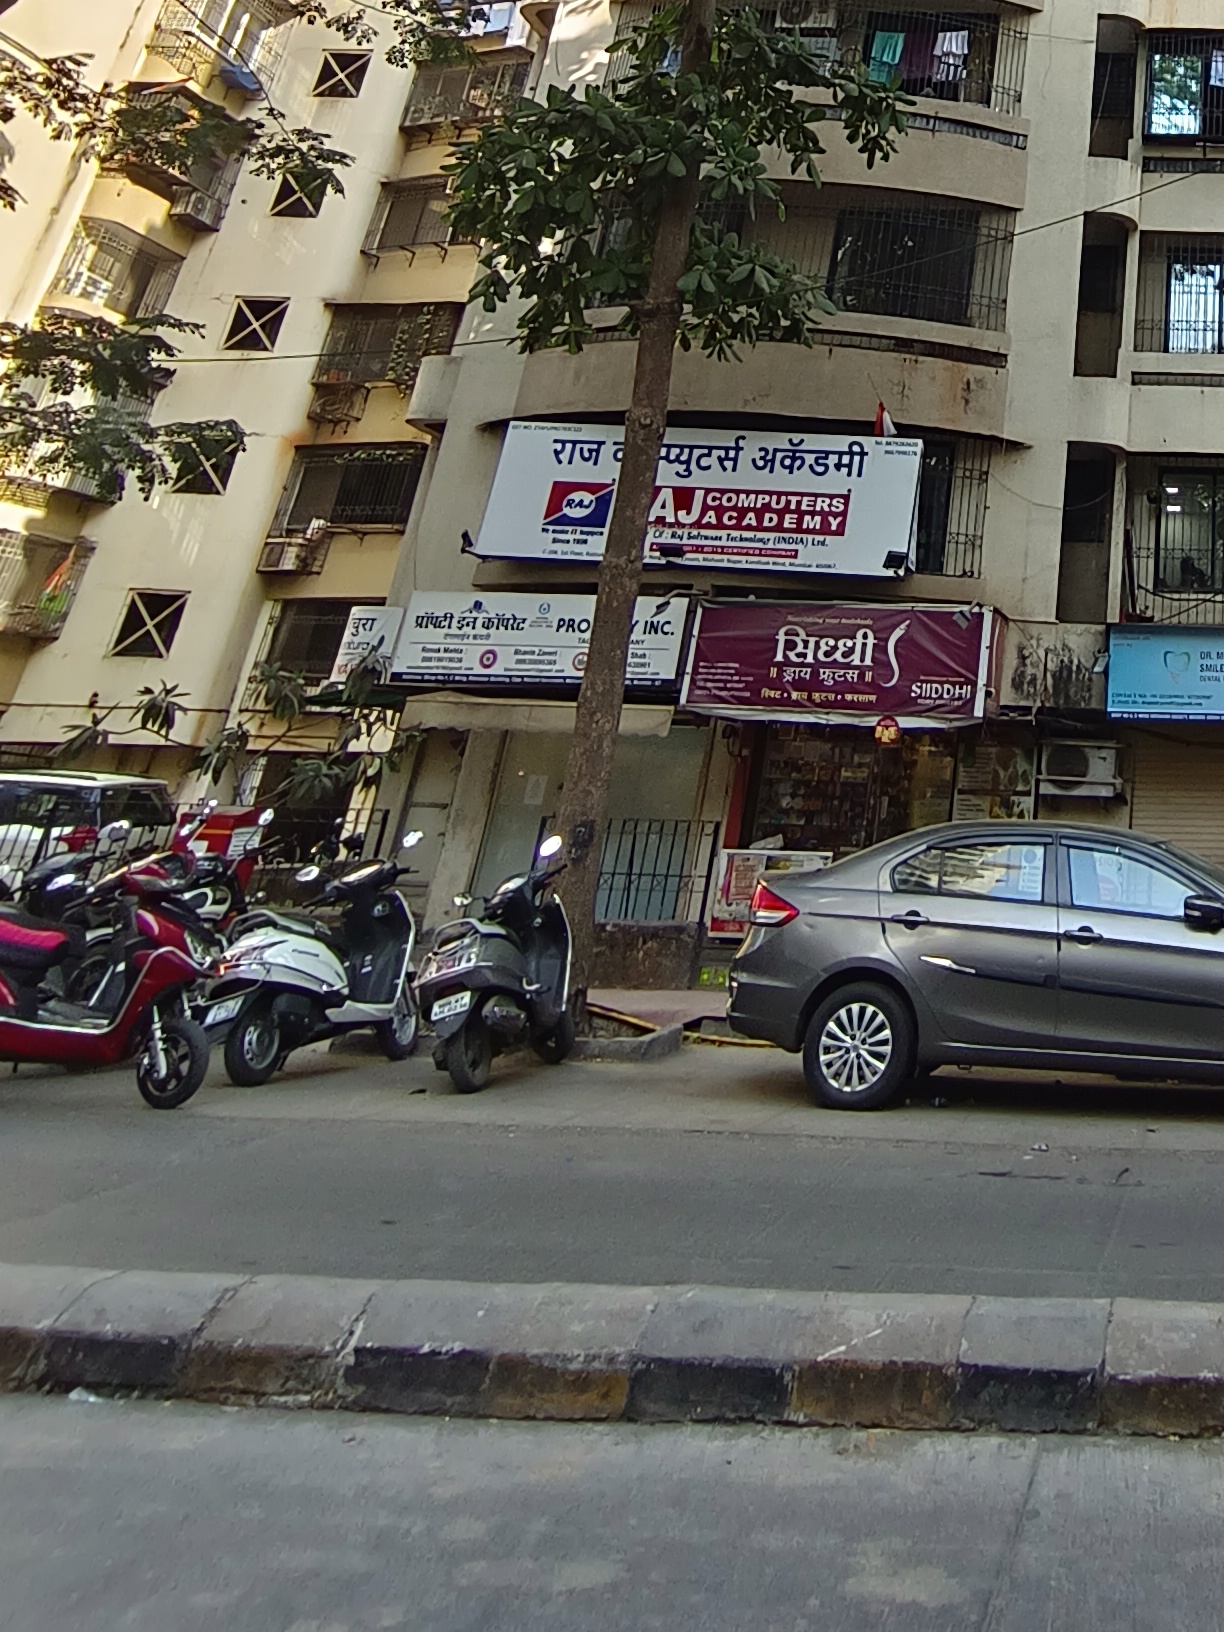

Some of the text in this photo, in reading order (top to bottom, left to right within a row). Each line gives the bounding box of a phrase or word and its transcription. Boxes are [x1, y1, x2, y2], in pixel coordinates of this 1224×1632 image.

[553, 438, 606, 466] राज
[751, 438, 868, 478] अकॅडमी
[564, 498, 595, 509] RAJ
[648, 487, 705, 524] AJ
[706, 491, 845, 513] COMPUTERS
[701, 511, 843, 531] ACADEMY
[725, 533, 770, 545] Technology
[773, 534, 808, 548] (INDIA)
[642, 620, 675, 636] INC.
[782, 667, 812, 682] ड्राय
[1200, 663, 1224, 673] SMILE
[911, 681, 971, 699] SIIDDHI
